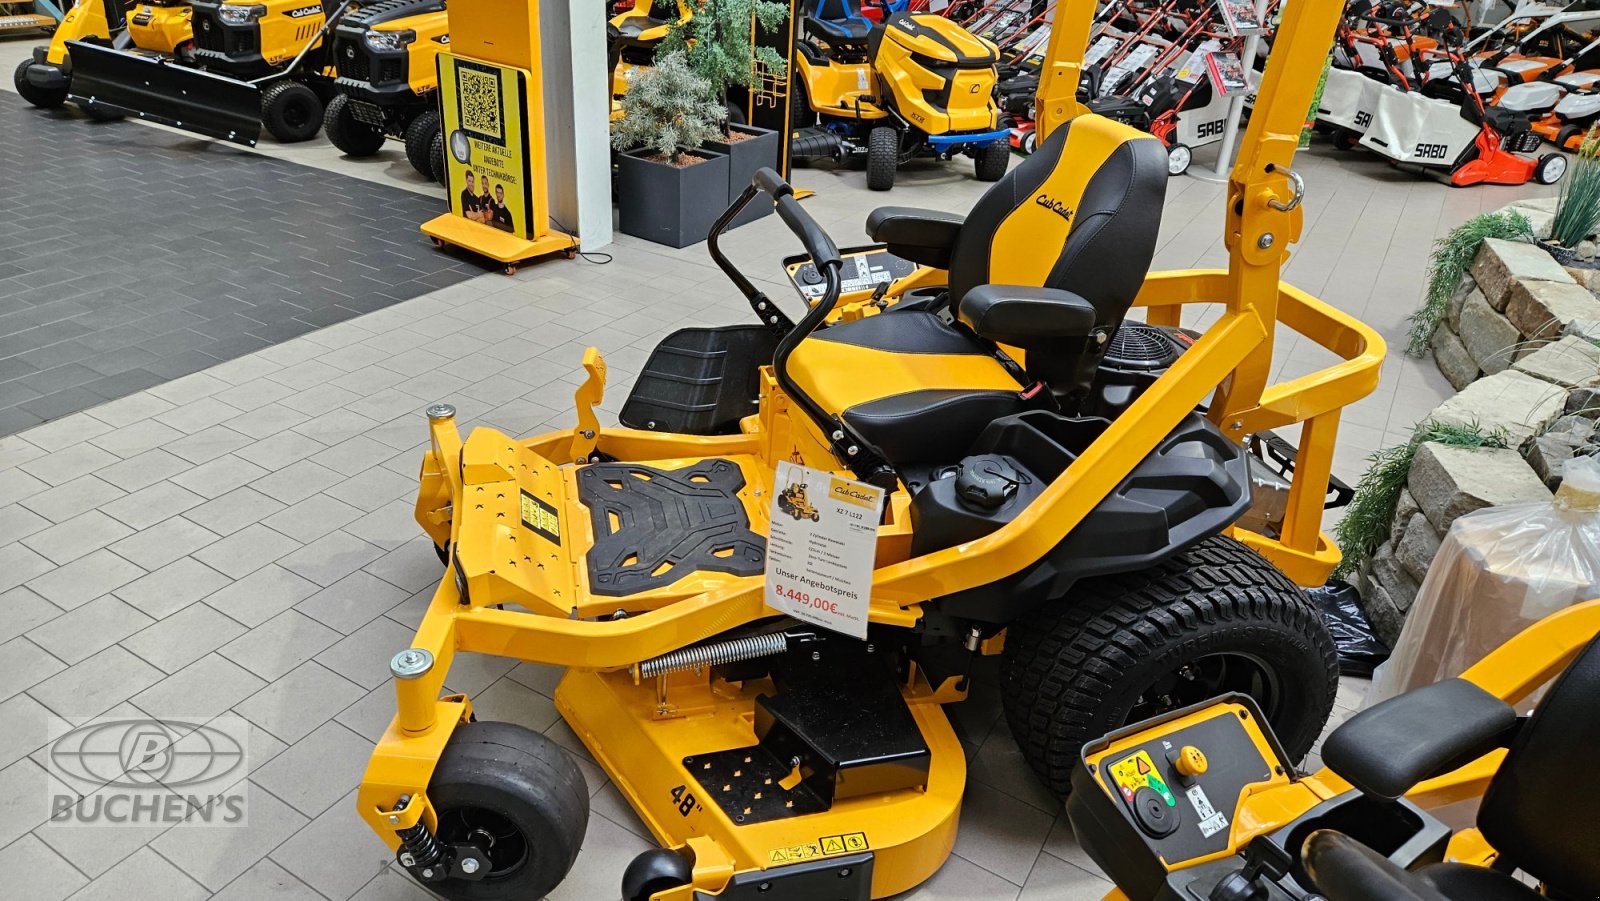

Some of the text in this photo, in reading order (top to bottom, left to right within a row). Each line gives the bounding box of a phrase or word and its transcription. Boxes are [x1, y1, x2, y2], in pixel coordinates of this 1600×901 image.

[1244, 92, 1257, 105] SA
[1197, 118, 1227, 139] SAB
[1354, 110, 1373, 128] SA
[492, 145, 512, 159] AKTUELLE
[1414, 143, 1448, 159] SABO
[1036, 194, 1074, 222] Cub Cadet
[834, 486, 876, 503] Cub Cadet
[775, 567, 858, 600] Unser Angebotspreis
[775, 584, 839, 615] 8.449,00€
[670, 784, 703, 817] 48"
